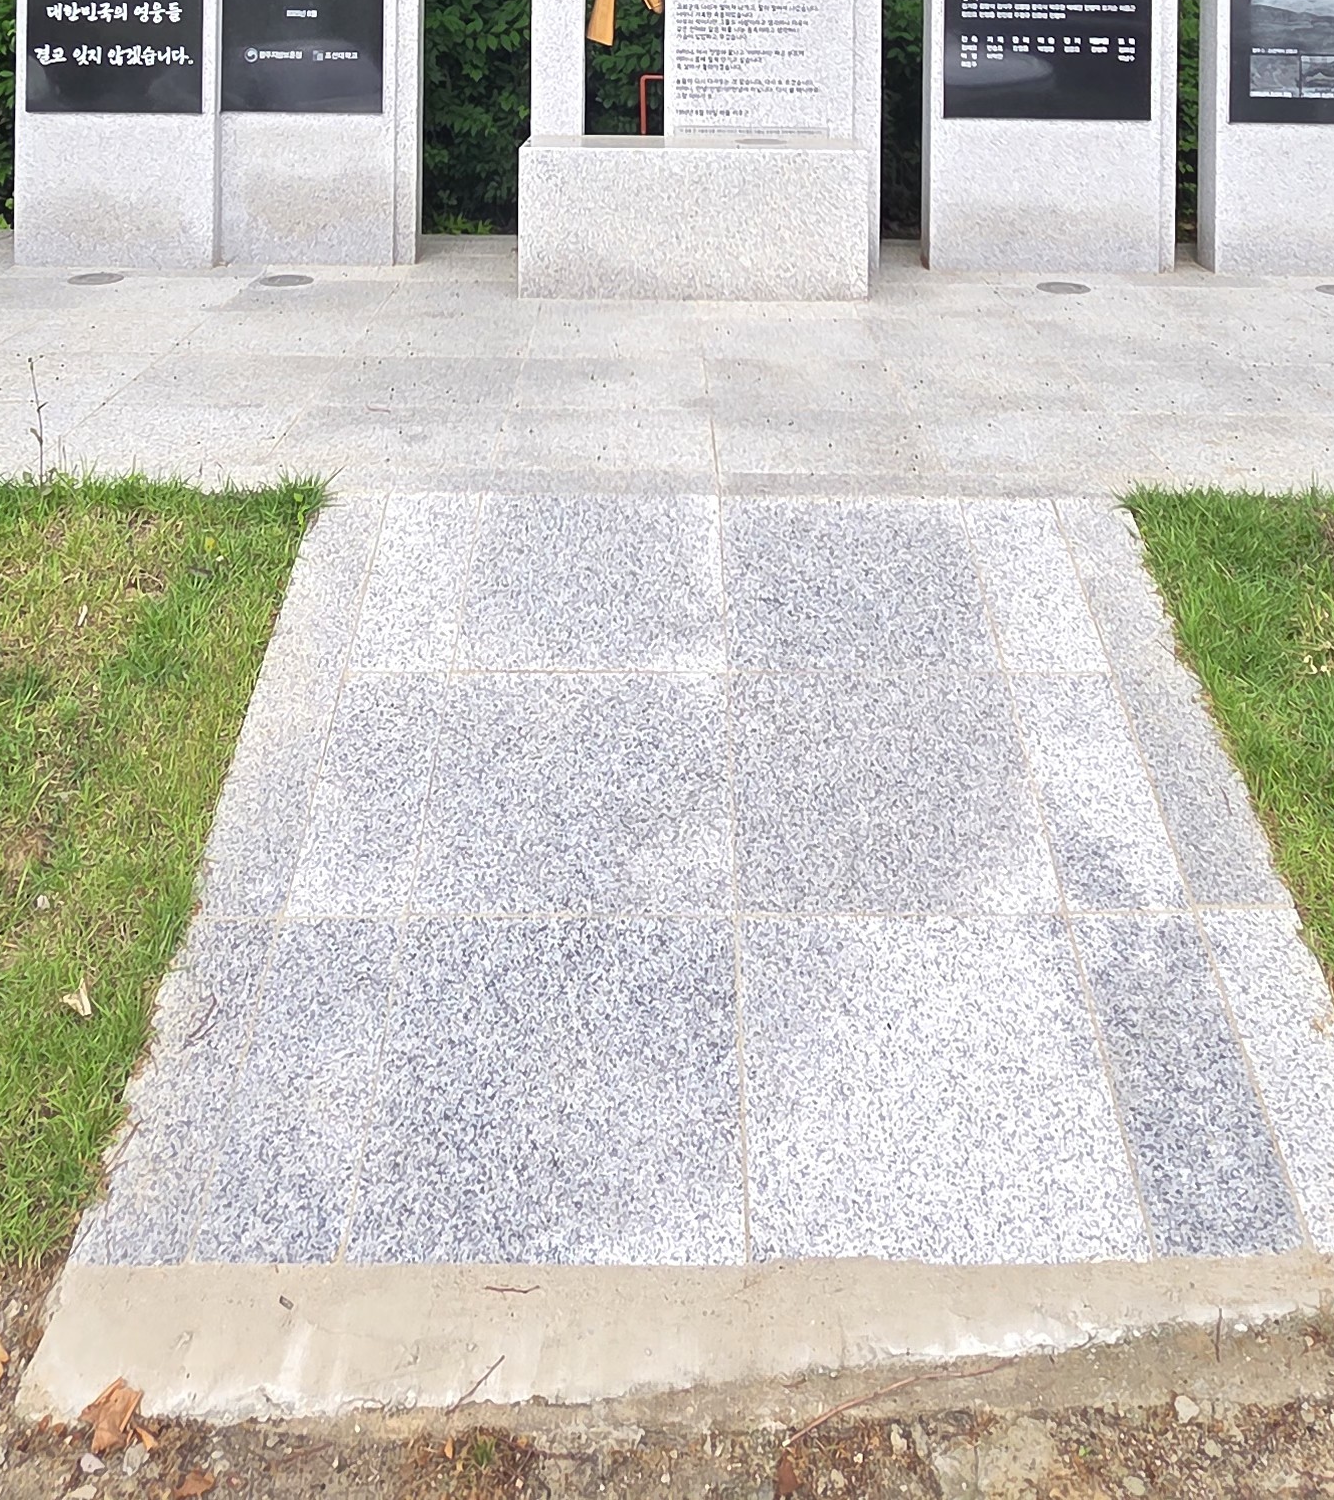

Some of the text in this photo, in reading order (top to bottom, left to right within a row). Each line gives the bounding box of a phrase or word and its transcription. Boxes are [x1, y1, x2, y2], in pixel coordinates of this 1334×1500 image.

[45, 1, 183, 24] 대한민국의 영웅들
[33, 43, 195, 67] 결코 잊지 않겠습니다.
